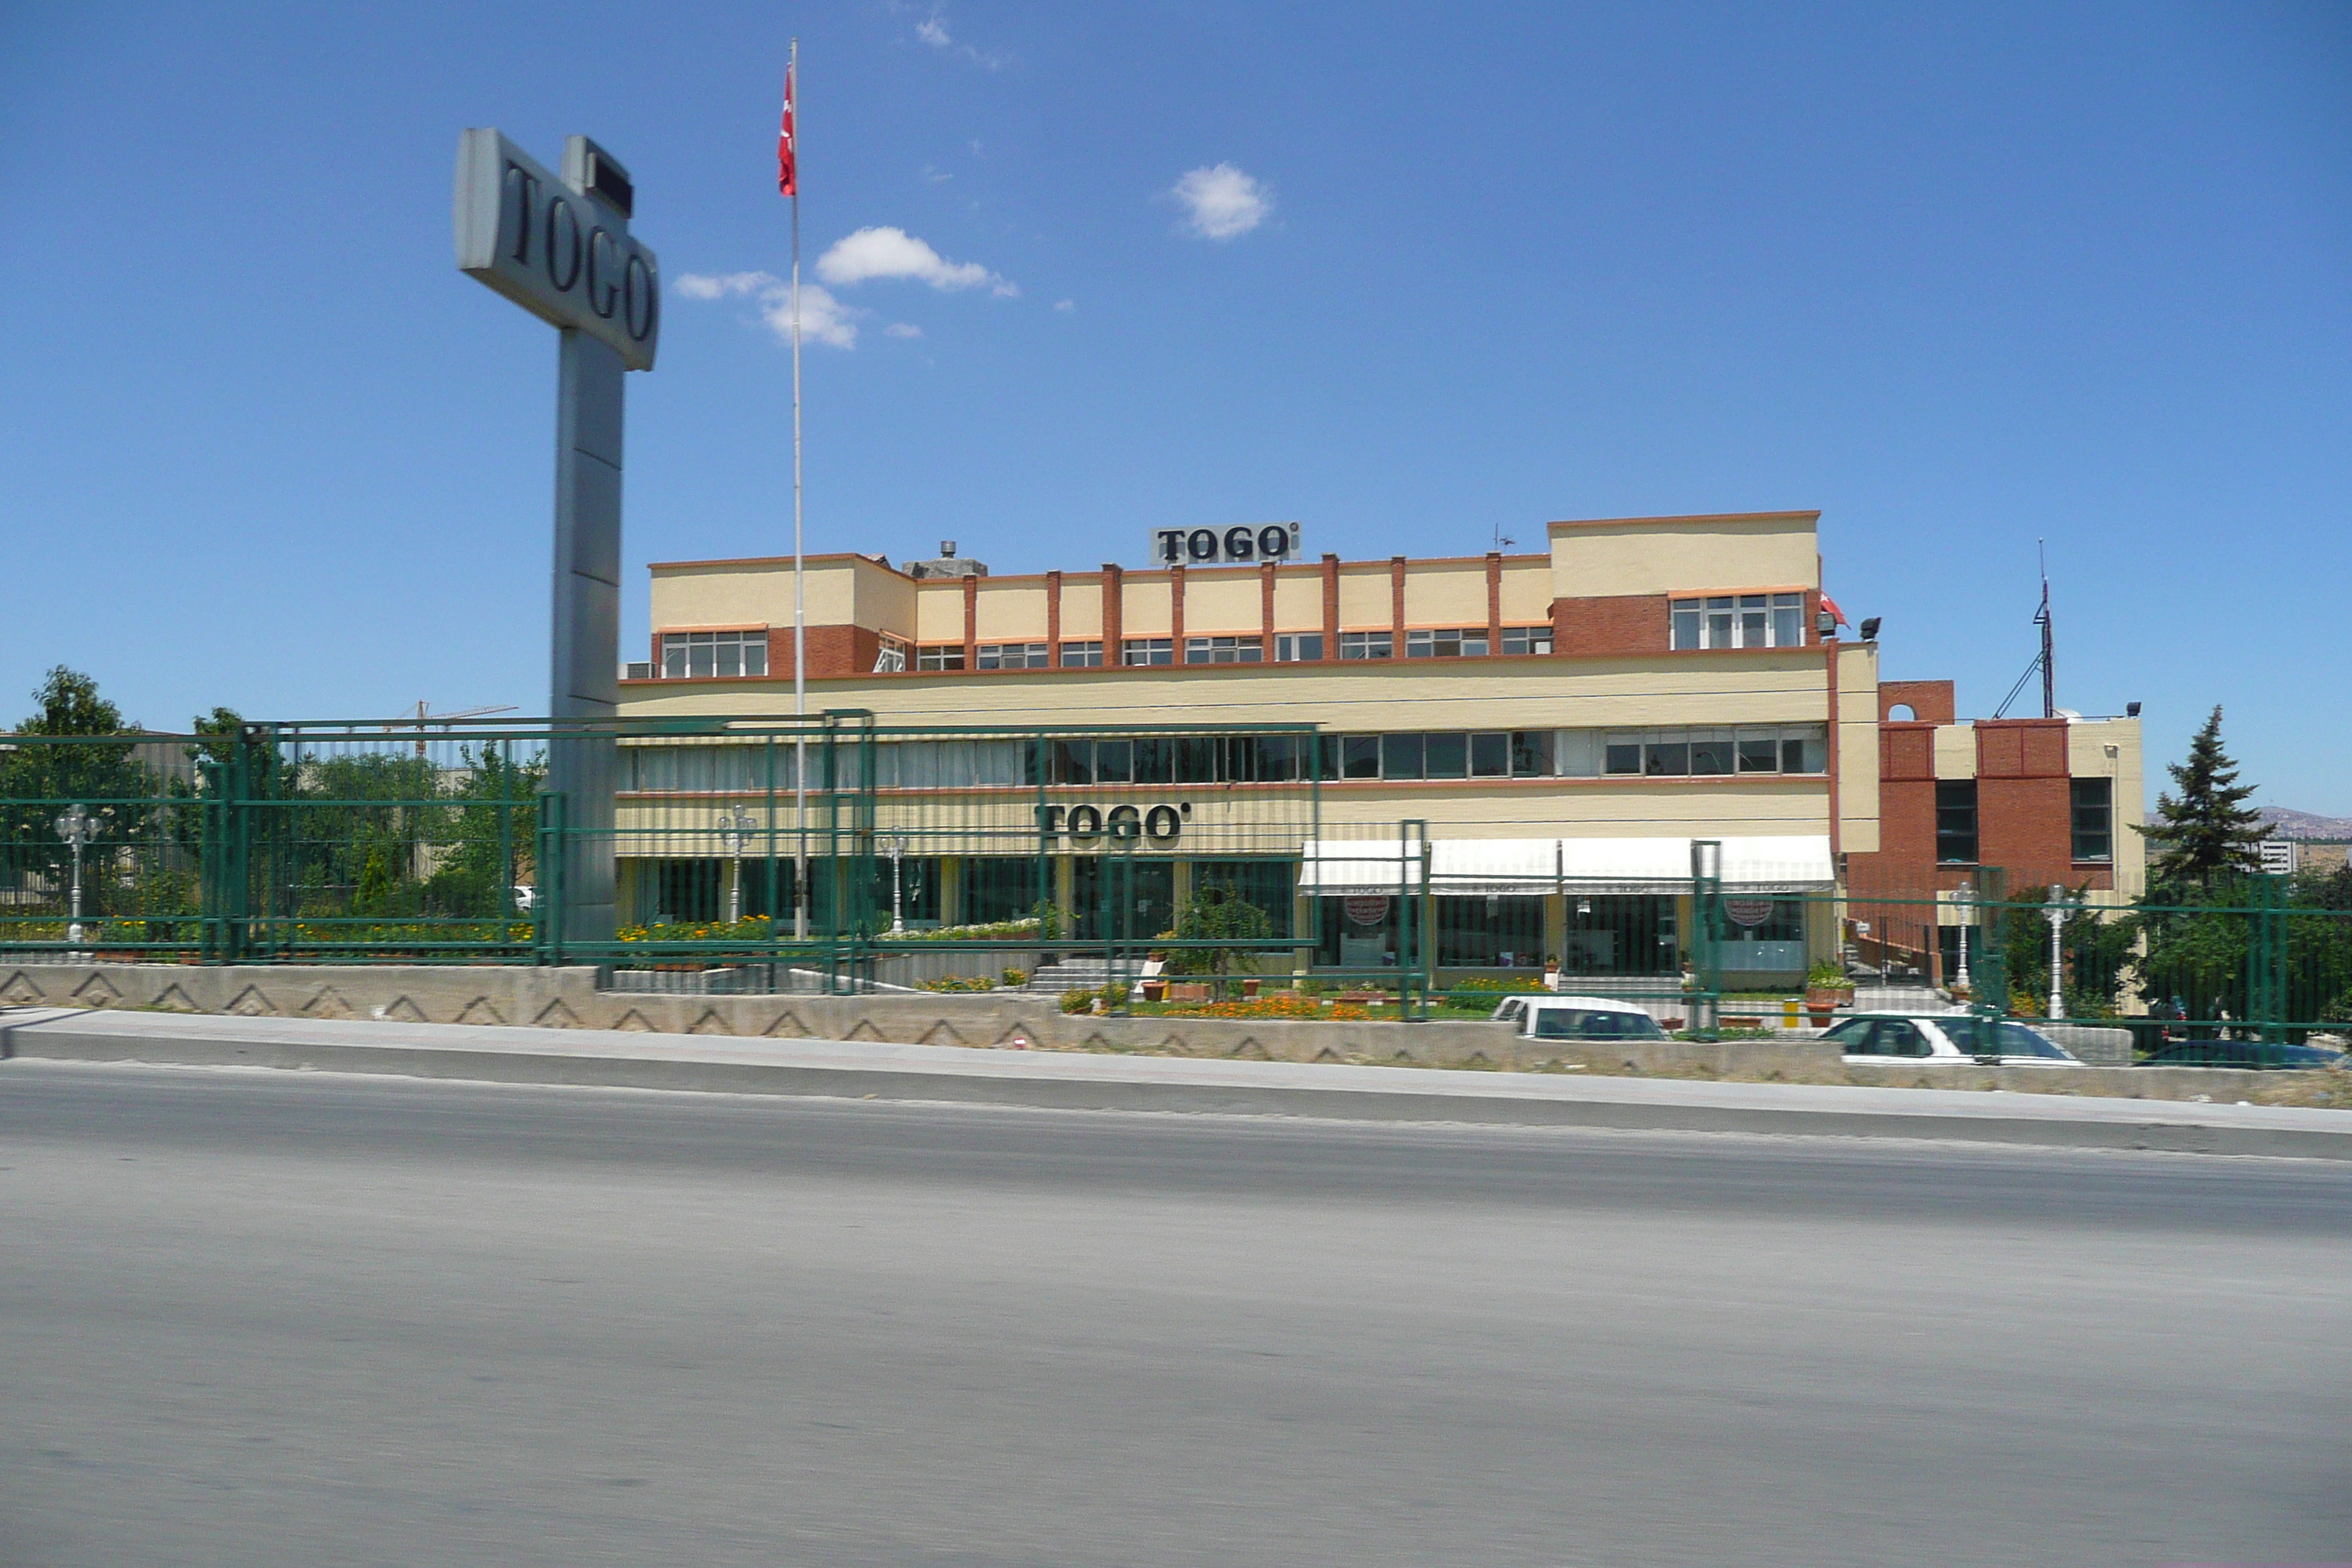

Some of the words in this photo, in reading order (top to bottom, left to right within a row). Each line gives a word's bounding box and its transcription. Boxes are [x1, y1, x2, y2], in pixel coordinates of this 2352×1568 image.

[505, 159, 654, 342] TOGO
[1158, 526, 1289, 560] TOGO
[1034, 805, 1180, 840] TOGO
[1484, 884, 1515, 893] TOGO
